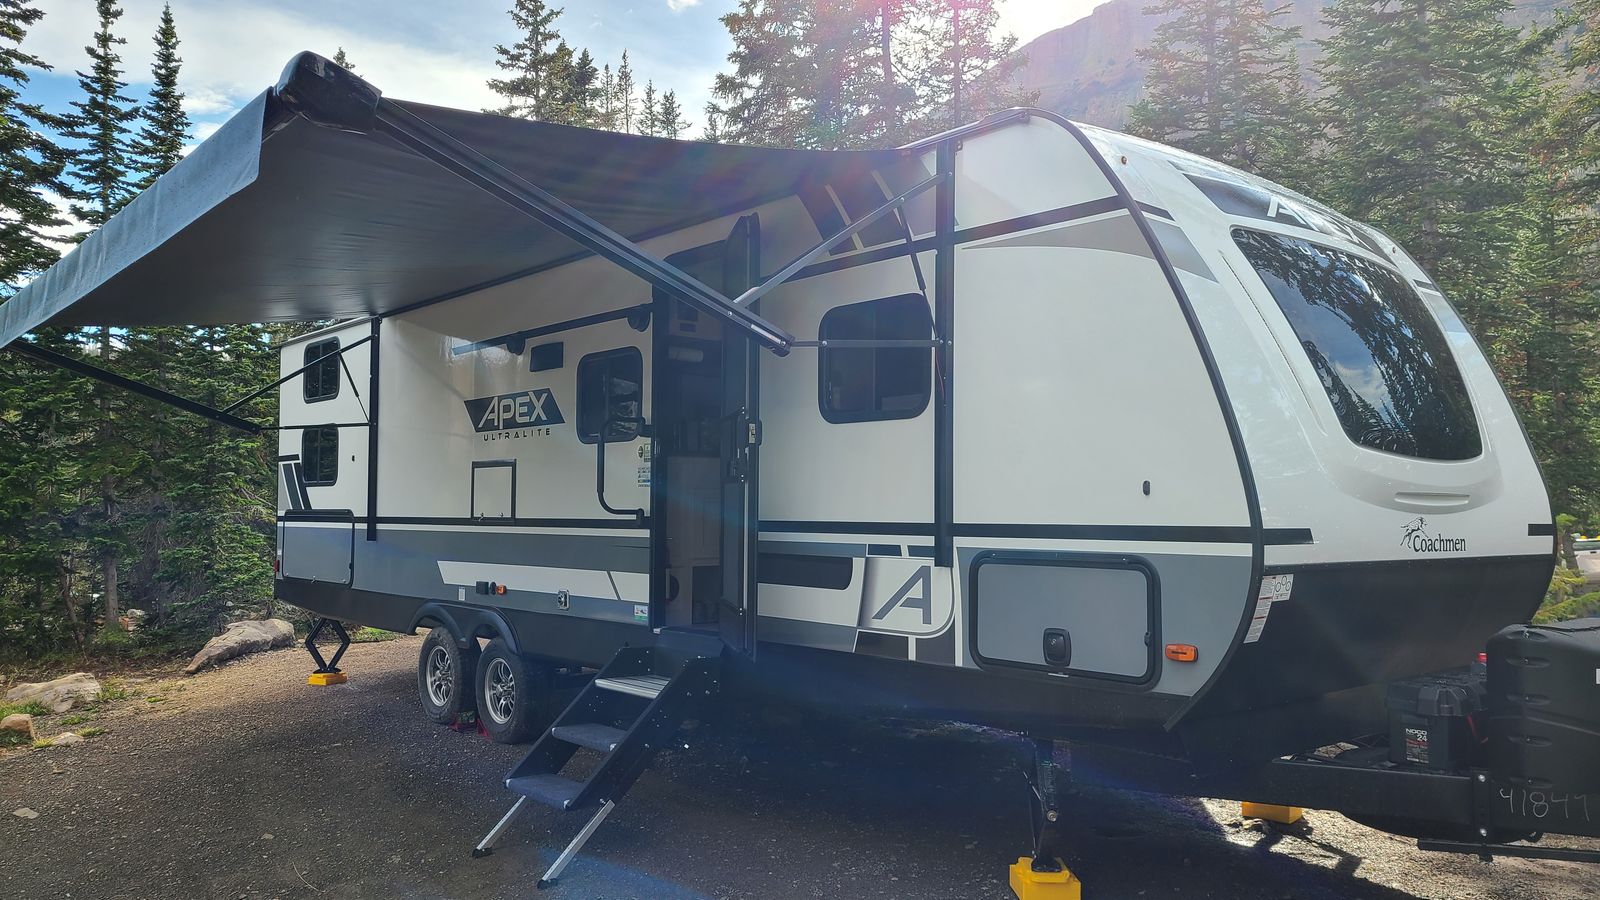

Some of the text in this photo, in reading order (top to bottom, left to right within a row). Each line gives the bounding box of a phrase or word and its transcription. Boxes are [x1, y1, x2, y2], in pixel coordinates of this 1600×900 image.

[477, 391, 548, 429] APEX
[483, 427, 550, 441] ULTRALITE
[1413, 533, 1466, 552] Coachmen
[871, 565, 932, 625] A
[1405, 728, 1428, 736] NOCO
[1417, 734, 1428, 742] 24
